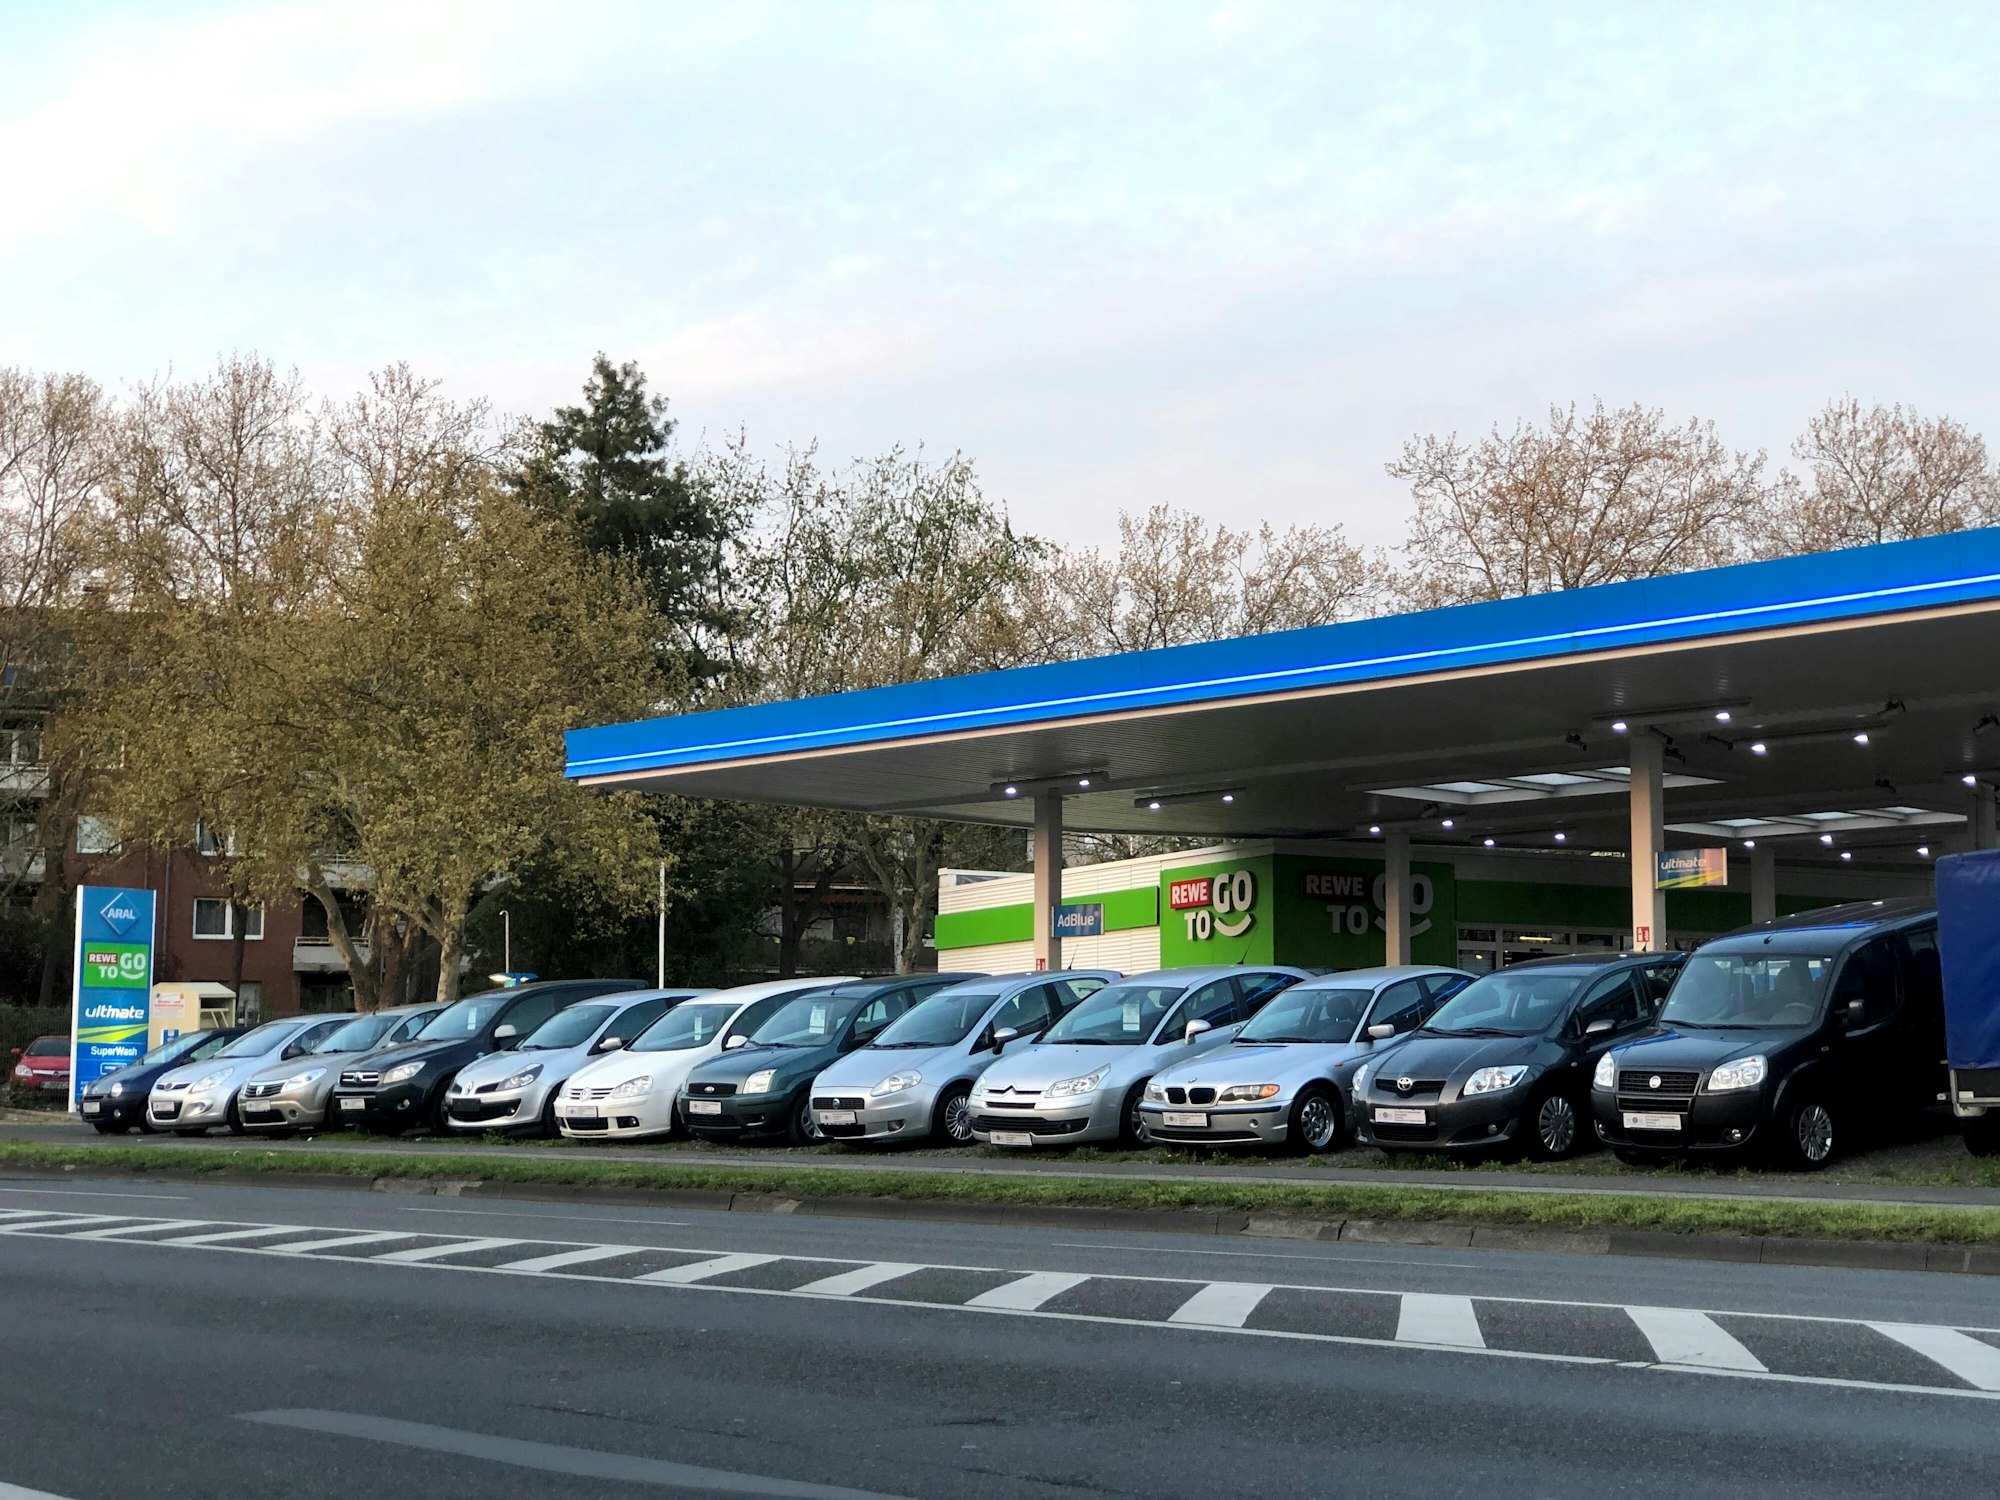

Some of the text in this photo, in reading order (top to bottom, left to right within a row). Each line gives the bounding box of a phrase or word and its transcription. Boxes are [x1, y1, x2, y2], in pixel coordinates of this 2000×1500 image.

[1661, 857, 1706, 869] ultimate
[1171, 870, 1252, 913] REWE GO
[1306, 874, 1363, 896] REWE
[107, 908, 136, 919] ARAL
[1327, 904, 1369, 935] TO
[1184, 909, 1211, 940] TO
[88, 953, 146, 970] REWE GO
[98, 965, 118, 979] TO
[85, 1005, 144, 1019] ultimate
[90, 1045, 138, 1057] SuperWash
